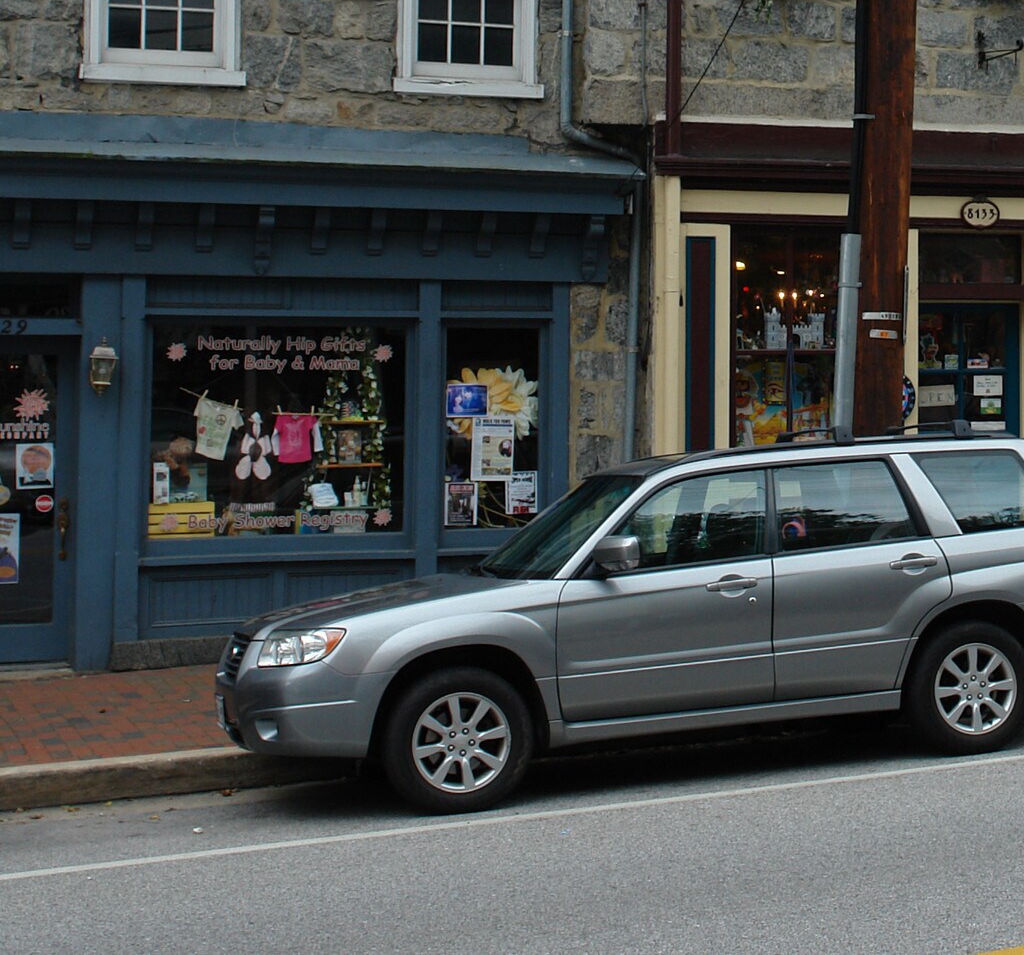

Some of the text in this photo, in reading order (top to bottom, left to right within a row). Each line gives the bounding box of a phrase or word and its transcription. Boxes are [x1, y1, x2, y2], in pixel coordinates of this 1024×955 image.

[967, 208, 995, 220] 8133
[197, 335, 366, 355] Naturally Hip Gifts
[209, 354, 360, 374] for Baby & Mama
[187, 512, 369, 533] Baby Shower Registry
